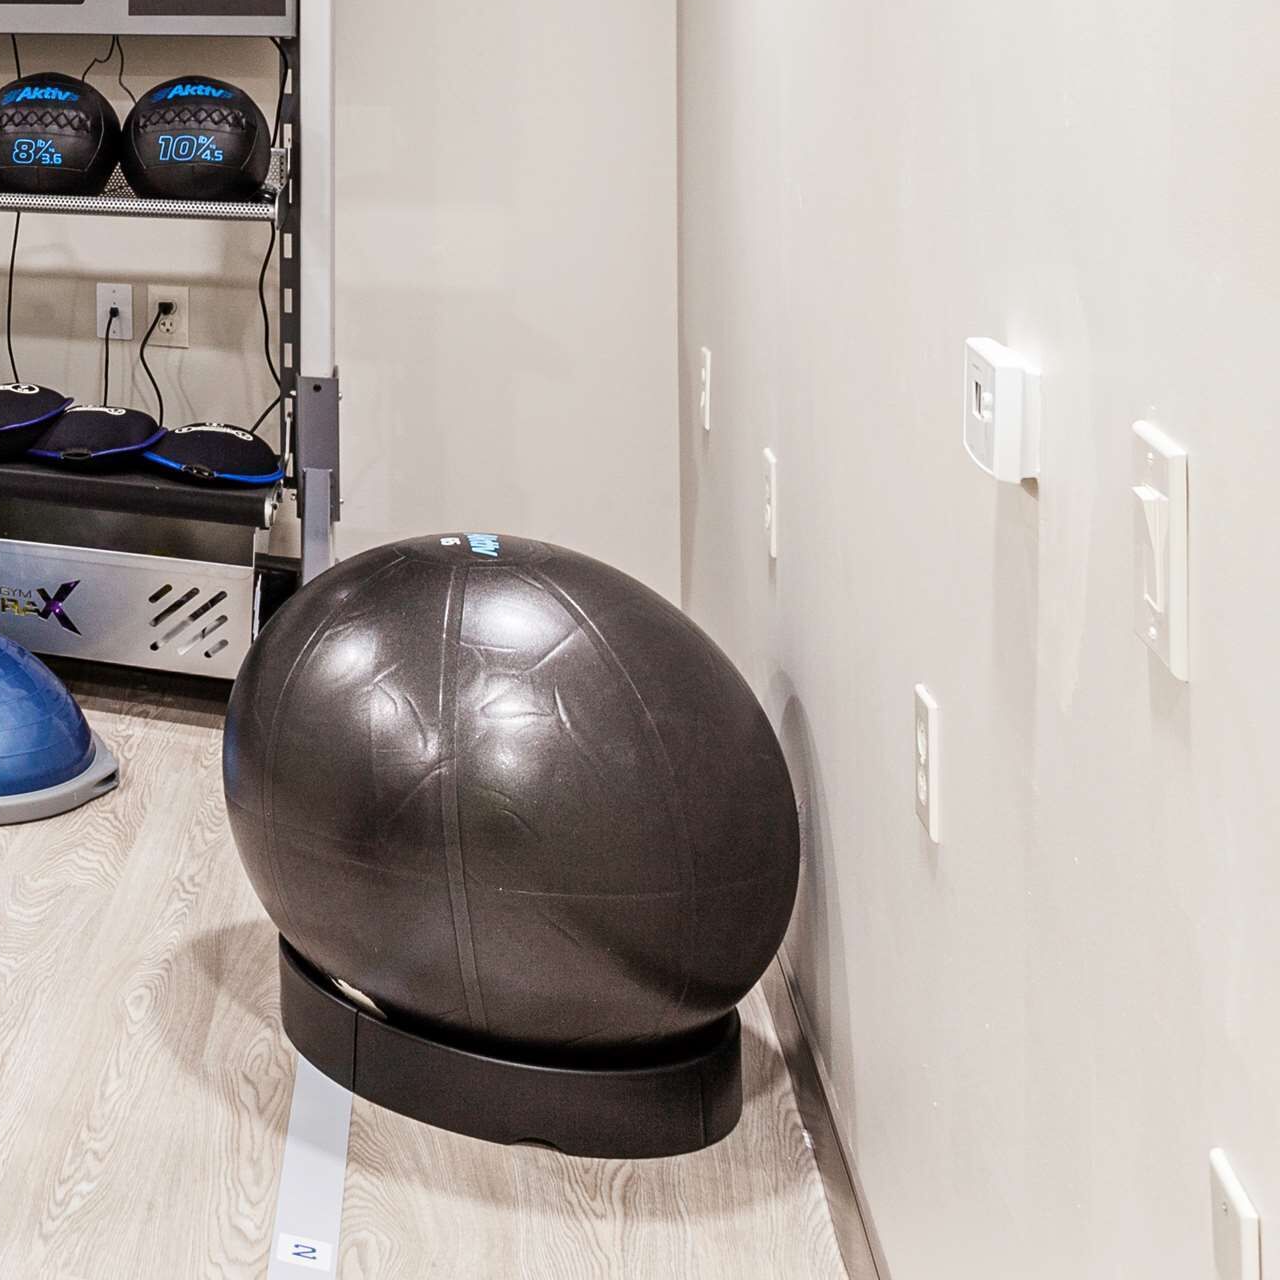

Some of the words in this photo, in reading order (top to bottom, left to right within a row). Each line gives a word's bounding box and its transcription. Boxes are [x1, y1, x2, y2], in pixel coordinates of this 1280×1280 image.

[13, 139, 35, 164] 8
[41, 153, 62, 164] 3.6
[159, 135, 197, 161] 10
[201, 150, 223, 161] 4.5
[292, 1243, 317, 1260] 2
